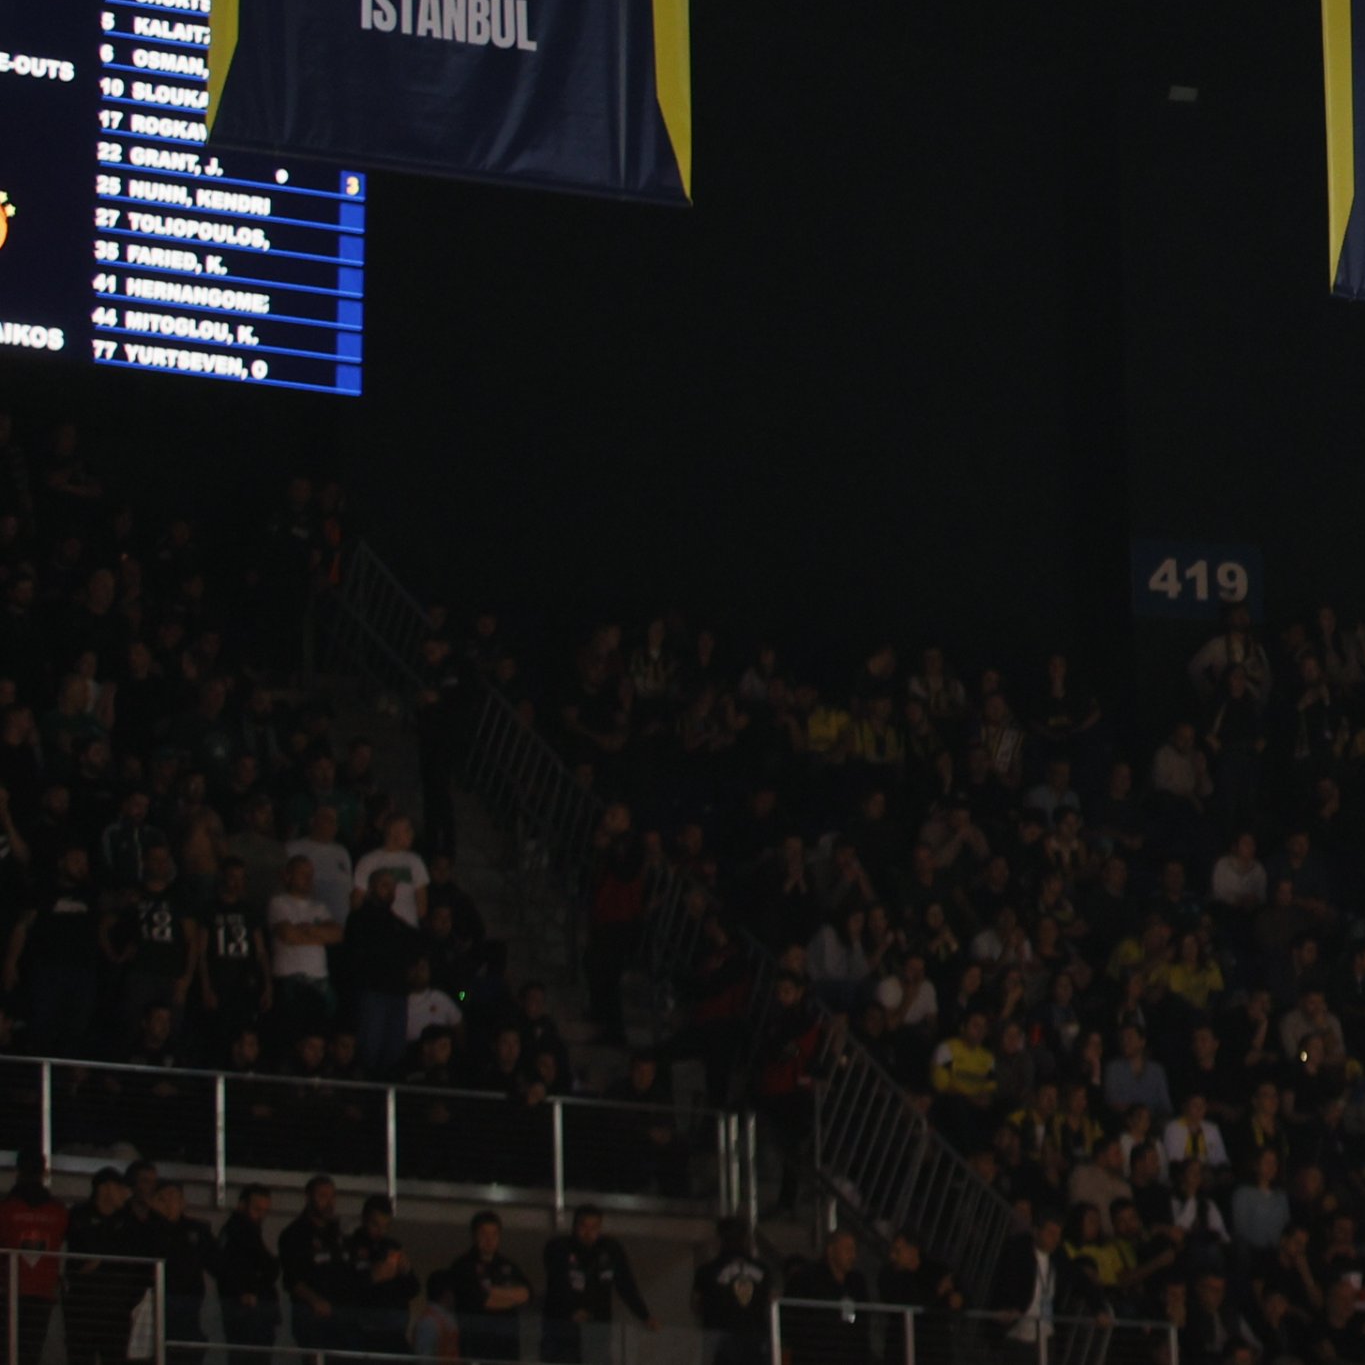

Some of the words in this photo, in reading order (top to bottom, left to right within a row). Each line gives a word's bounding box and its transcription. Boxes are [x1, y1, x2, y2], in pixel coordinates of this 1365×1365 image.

[101, 12, 115, 31] 5
[100, 44, 114, 62] 6
[133, 49, 210, 80] OSMAN,
[99, 77, 124, 97] 10
[99, 110, 123, 129] 17
[97, 141, 122, 162] 22
[130, 146, 202, 177] GRANT,
[204, 157, 224, 177] J.
[345, 175, 360, 196] 3
[96, 174, 121, 195] 25
[129, 179, 193, 208] NUNN,
[196, 188, 271, 216] KENDRI
[95, 207, 120, 227] 27
[128, 212, 271, 251] TOLIOPOULOS,
[94, 240, 119, 261] 35
[127, 244, 203, 274] FARIED,
[206, 254, 228, 275] K.
[92, 273, 117, 294] 41
[92, 306, 117, 327] 44
[125, 310, 234, 345] MITOGLOU,
[92, 339, 117, 360] 77
[124, 344, 249, 380] YURTSEVEN,
[1148, 557, 1249, 603] 419
